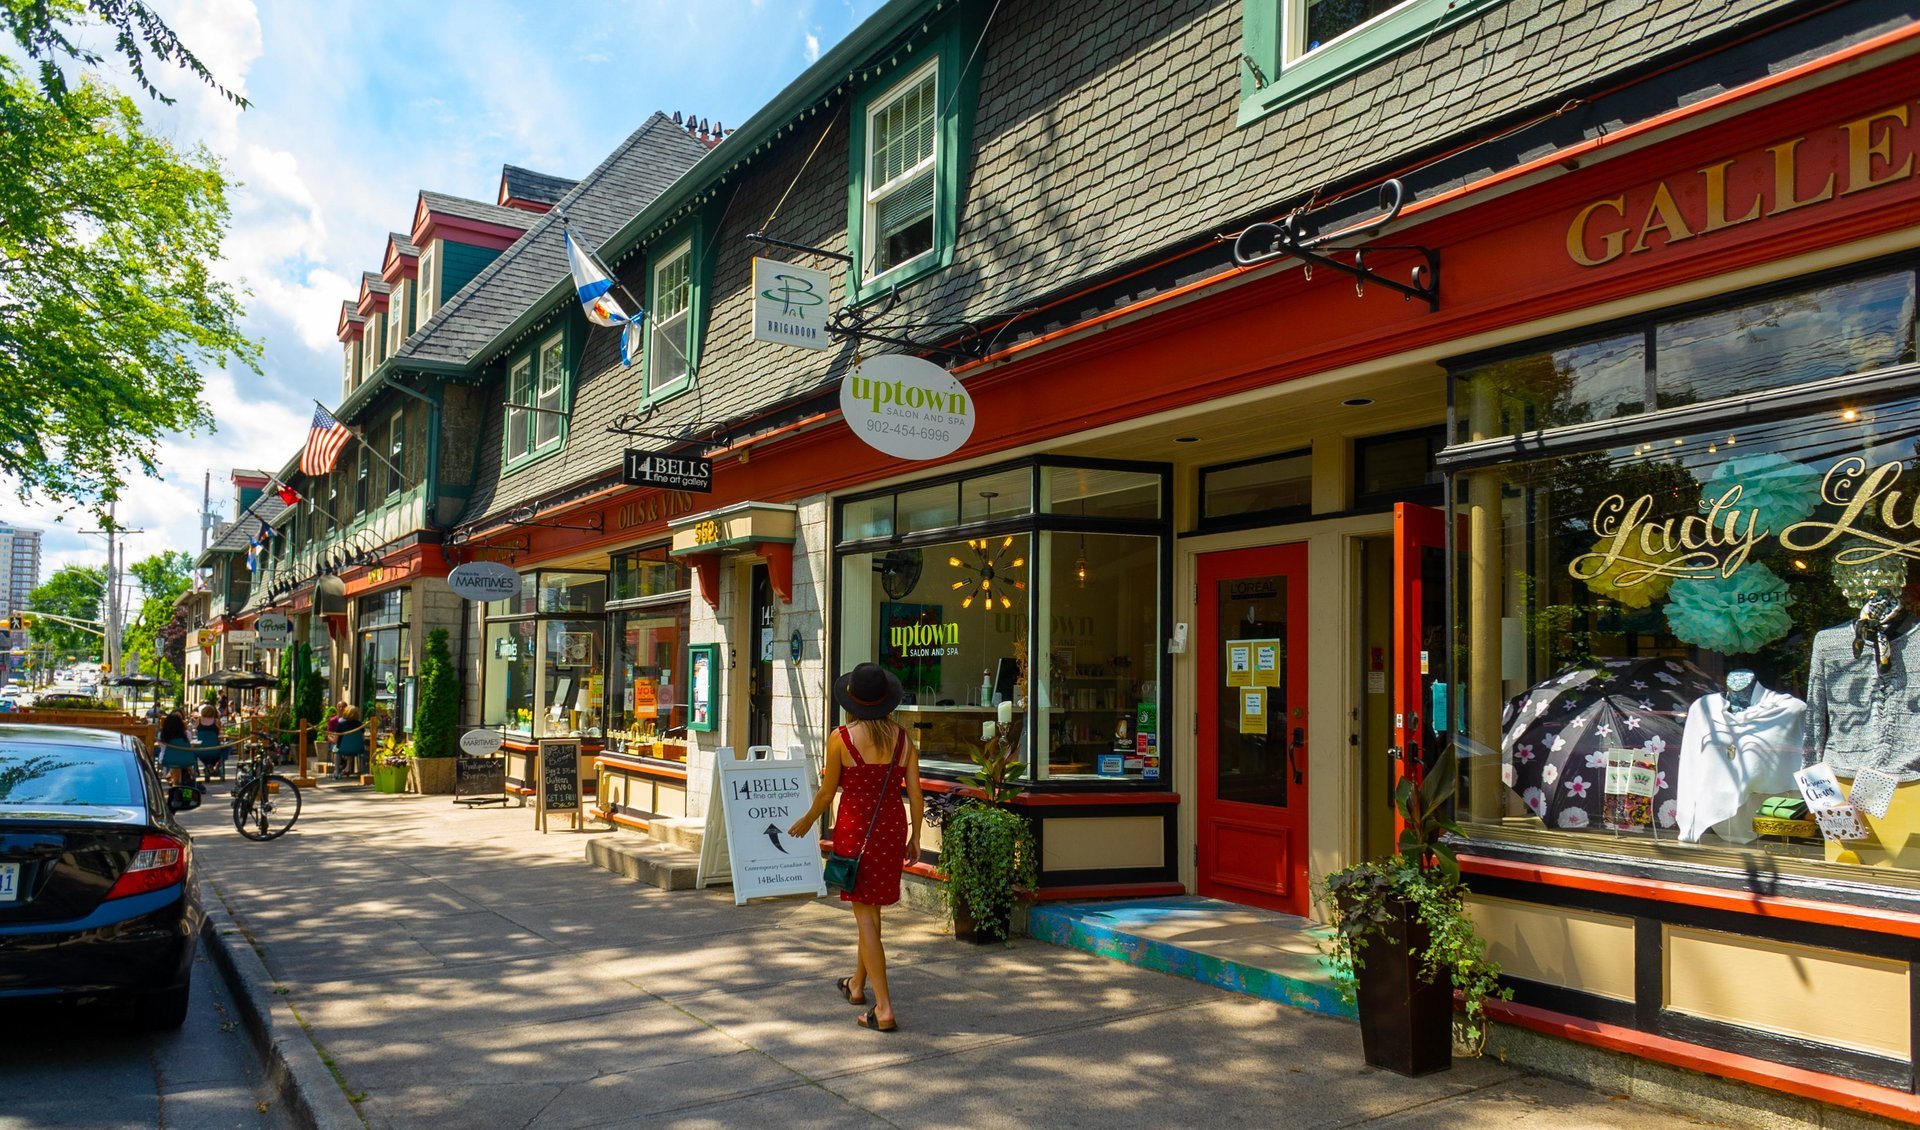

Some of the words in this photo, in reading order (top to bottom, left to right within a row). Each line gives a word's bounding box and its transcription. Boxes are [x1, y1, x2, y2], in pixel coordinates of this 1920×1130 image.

[1566, 101, 1920, 267] GALLE
[768, 320, 817, 339] BRIGADOON
[851, 376, 967, 416] uptown
[886, 407, 919, 419] SALON
[923, 414, 944, 423] AND
[948, 417, 966, 426] SPA
[866, 419, 950, 442] 902-454-6996
[629, 454, 654, 481] 14
[655, 457, 709, 478] BELLS
[653, 473, 668, 483] fine
[669, 475, 681, 483] art
[682, 476, 708, 488] gallery
[618, 499, 646, 530] OILS
[647, 496, 658, 522] &
[662, 490, 693, 517] VINS
[1568, 484, 1770, 588] Lady
[455, 576, 514, 589] MARITIMES
[890, 621, 960, 657] uptown
[910, 648, 930, 657] SALON
[931, 648, 945, 656] AND
[946, 647, 959, 655] SPA
[463, 739, 499, 747] MARITIMES
[732, 780, 752, 800] 14
[753, 777, 799, 792] BELLS
[778, 791, 800, 800] gallery
[748, 806, 789, 819] OPEN
[744, 863, 779, 872] Contemporary
[780, 861, 802, 869] Canadian
[758, 874, 803, 885] 14Bells.com
